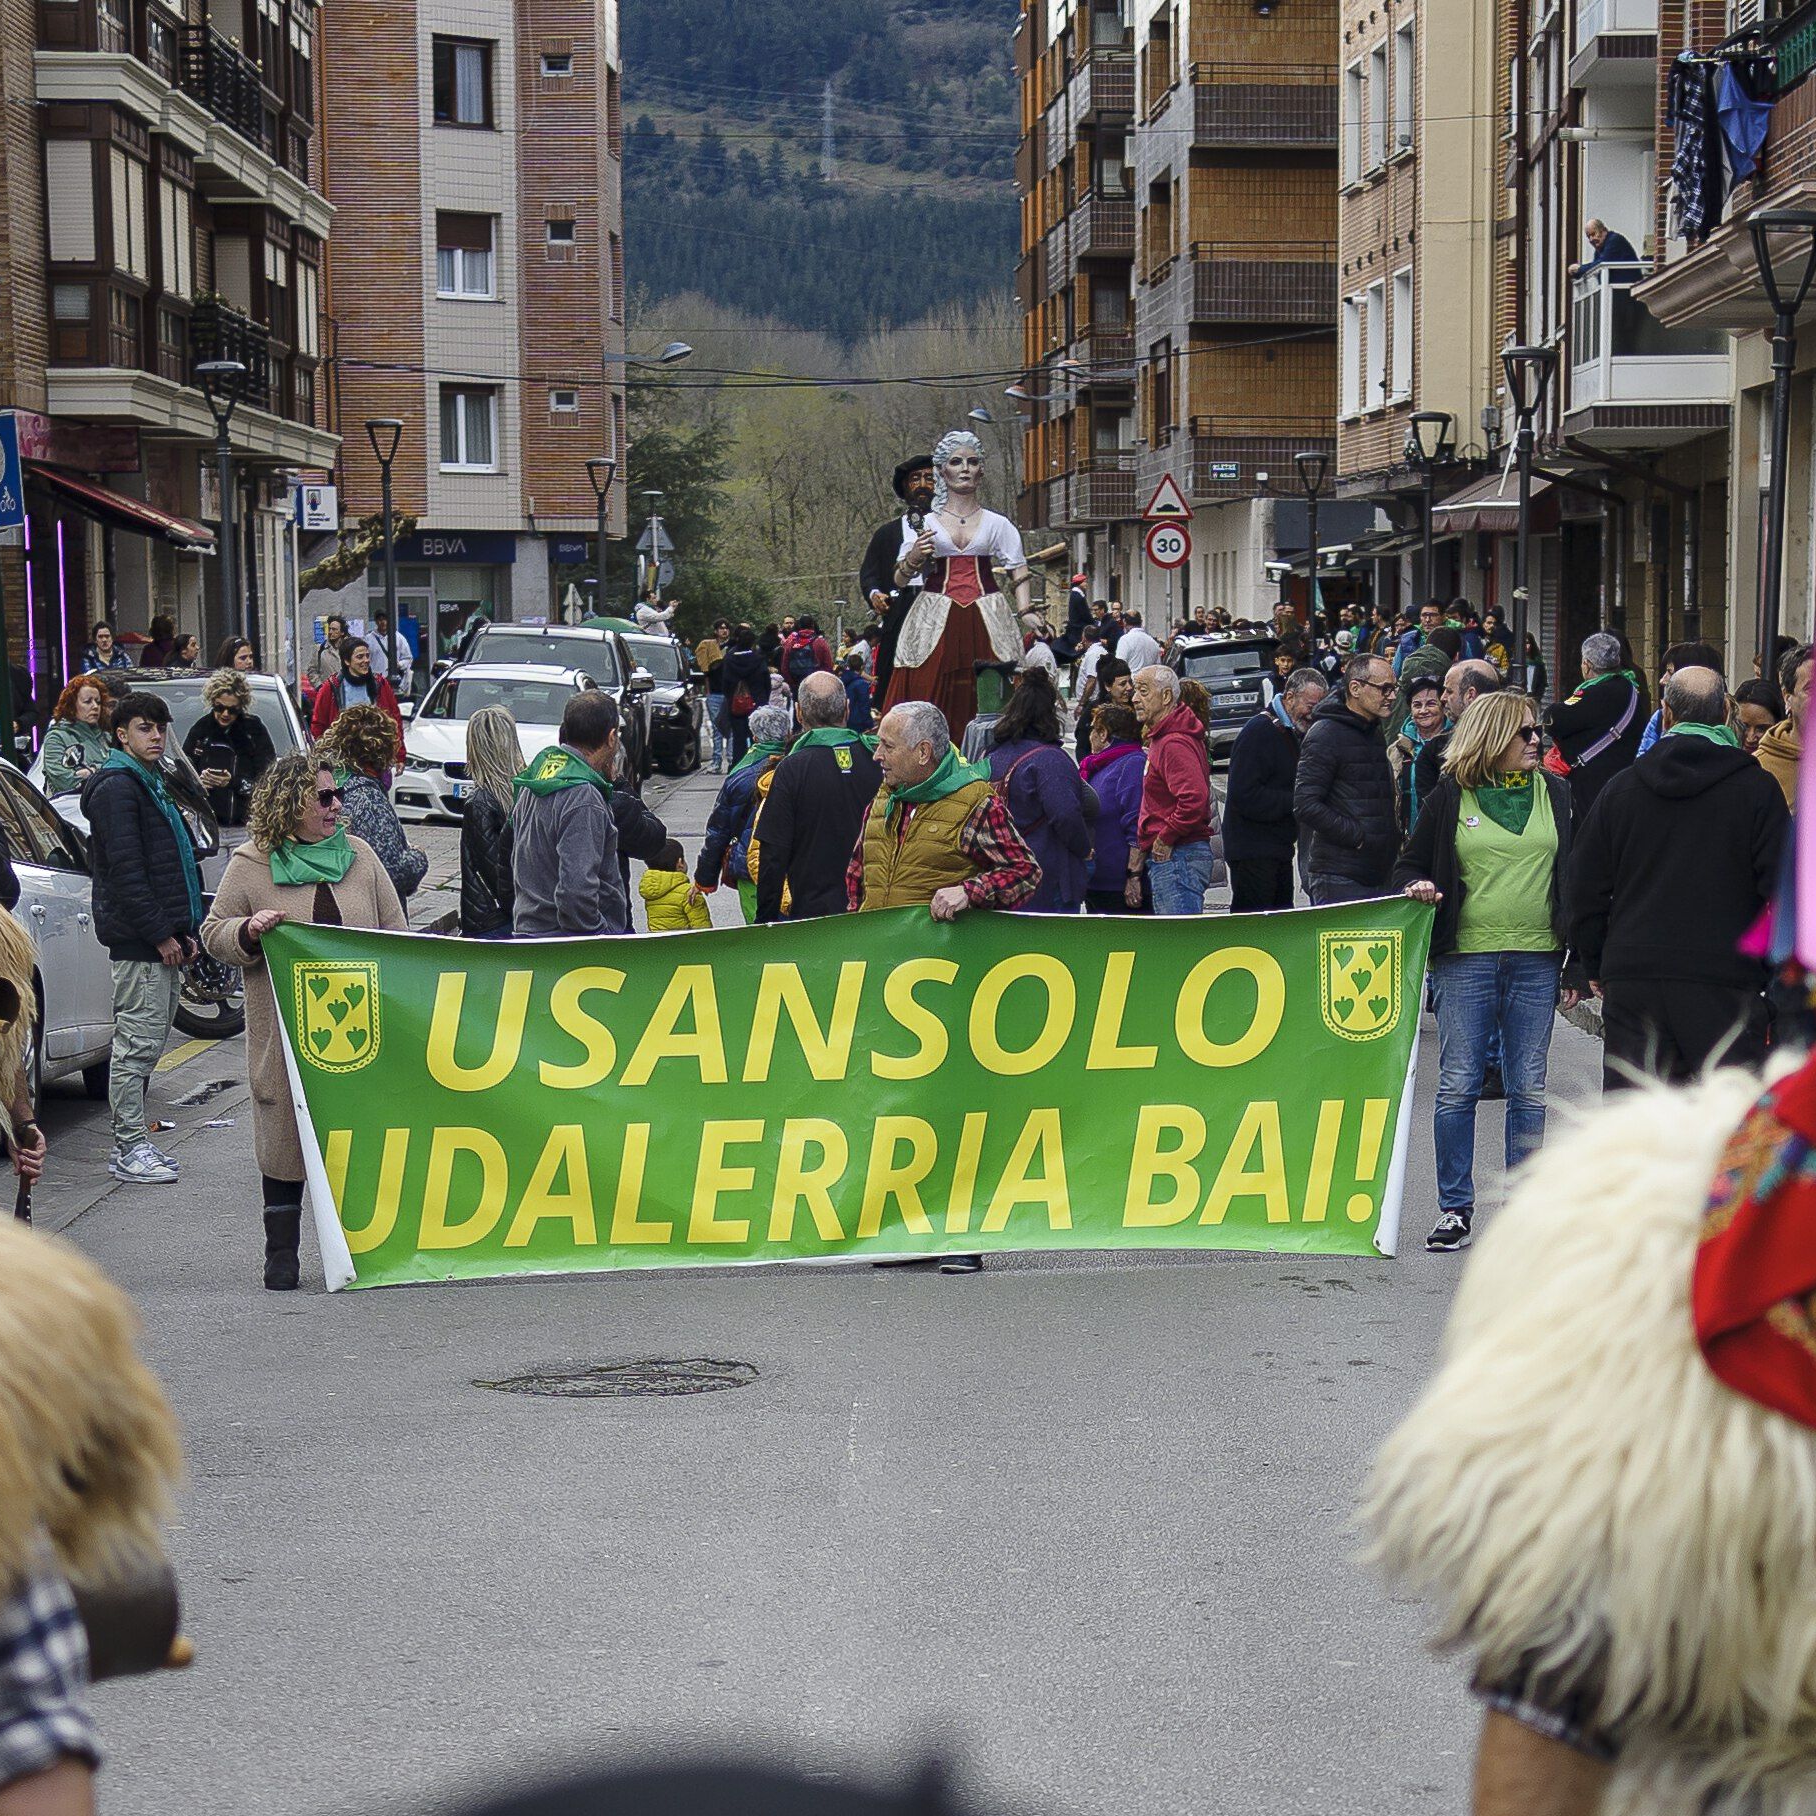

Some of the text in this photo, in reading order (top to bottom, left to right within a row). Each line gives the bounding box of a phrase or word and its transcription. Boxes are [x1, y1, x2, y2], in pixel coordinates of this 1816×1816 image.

[423, 538, 467, 555] BBVA
[558, 543, 584, 553] BBVA
[1156, 537, 1181, 554] 30
[425, 946, 1287, 1092] USANSOLO
[325, 1098, 1391, 1256] UDALERRIA BAI!
